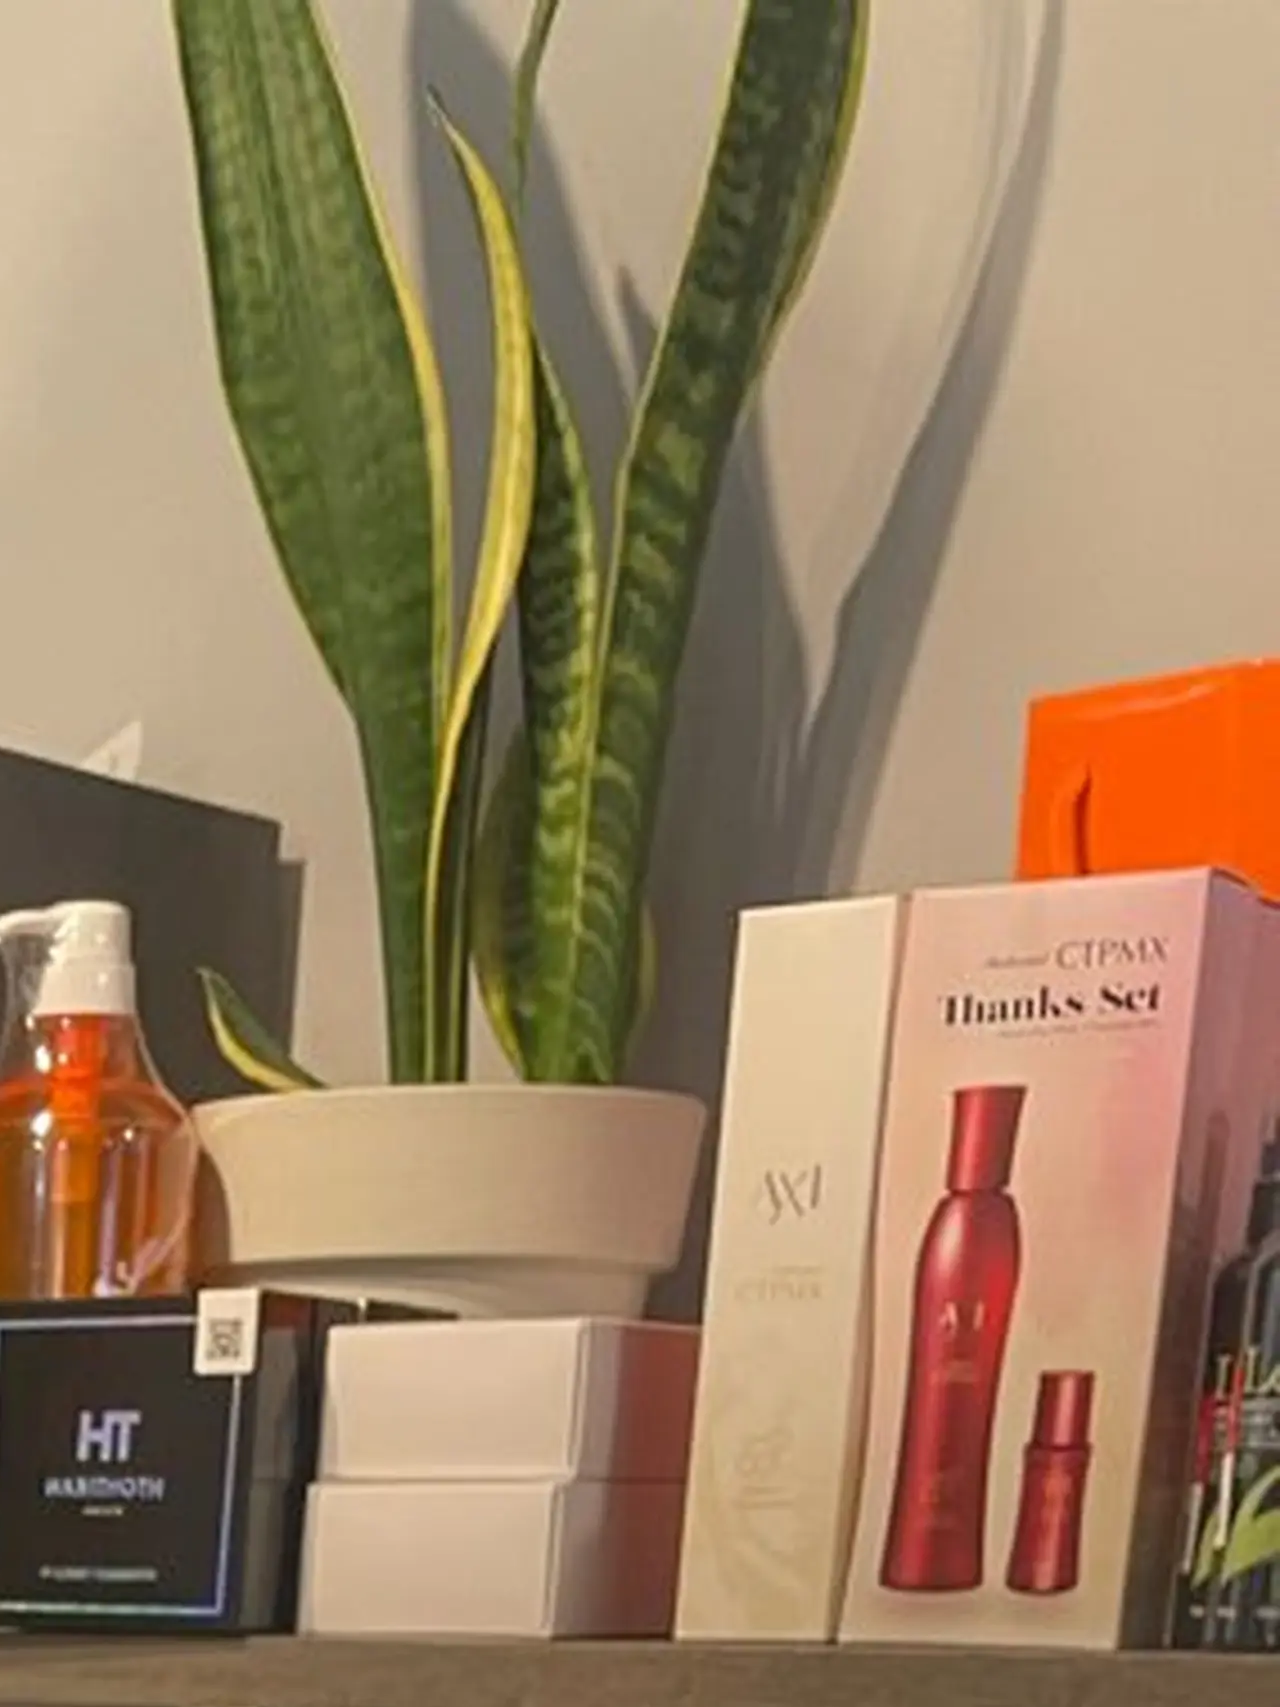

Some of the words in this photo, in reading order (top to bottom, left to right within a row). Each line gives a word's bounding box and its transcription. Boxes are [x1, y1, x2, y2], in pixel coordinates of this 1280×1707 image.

[938, 986, 1085, 1026] Thanks
[1098, 983, 1161, 1014] Set
[75, 1409, 142, 1463] HT
